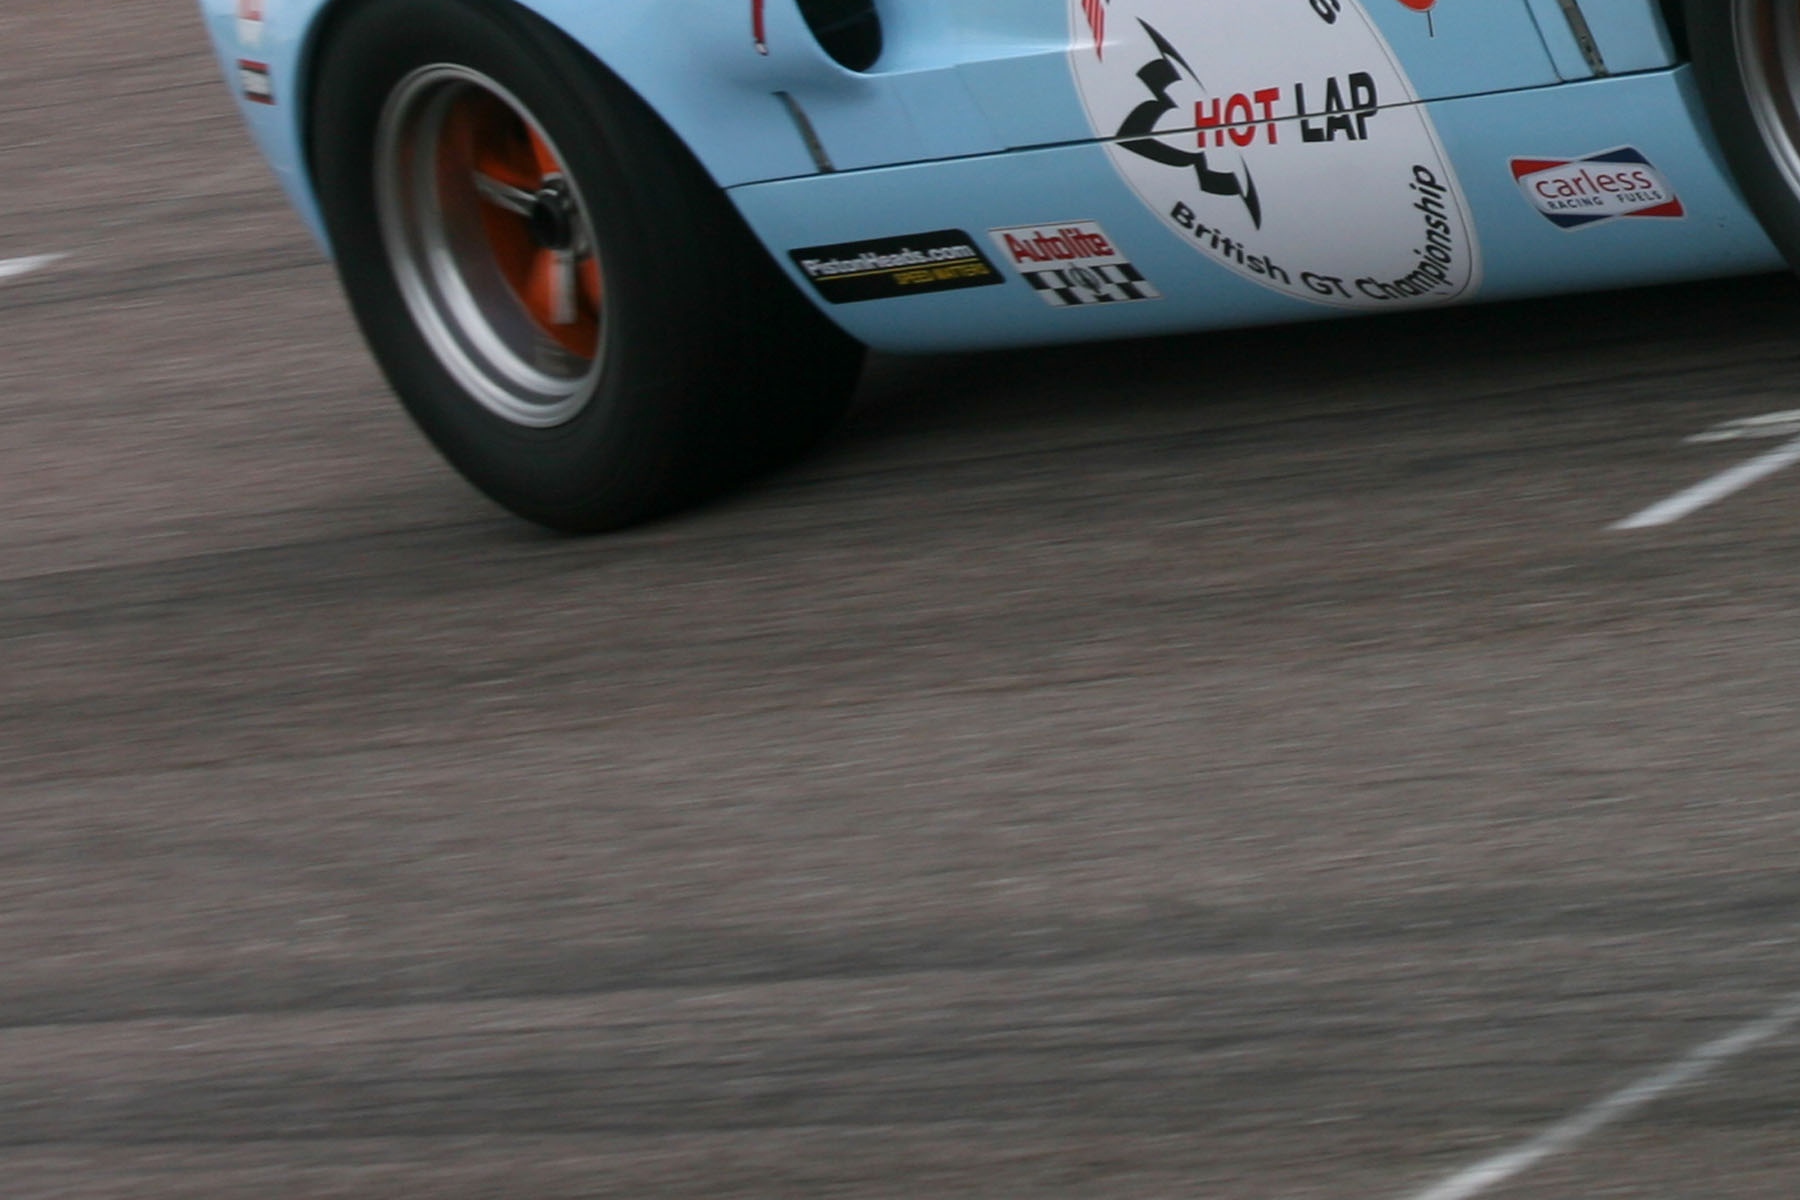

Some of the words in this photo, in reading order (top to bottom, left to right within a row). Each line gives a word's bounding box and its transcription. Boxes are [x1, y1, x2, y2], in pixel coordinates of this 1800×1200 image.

[1194, 87, 1281, 149] HOT
[1294, 70, 1378, 143] LAP
[1535, 166, 1653, 199] carless
[1547, 195, 1604, 211] RACING
[1618, 189, 1663, 205] FUELS
[1003, 227, 1116, 264] Autolite
[1169, 200, 1292, 286] British
[1300, 271, 1354, 300] GT
[1355, 163, 1453, 301] Championship
[801, 244, 977, 277] PistonHeads.com
